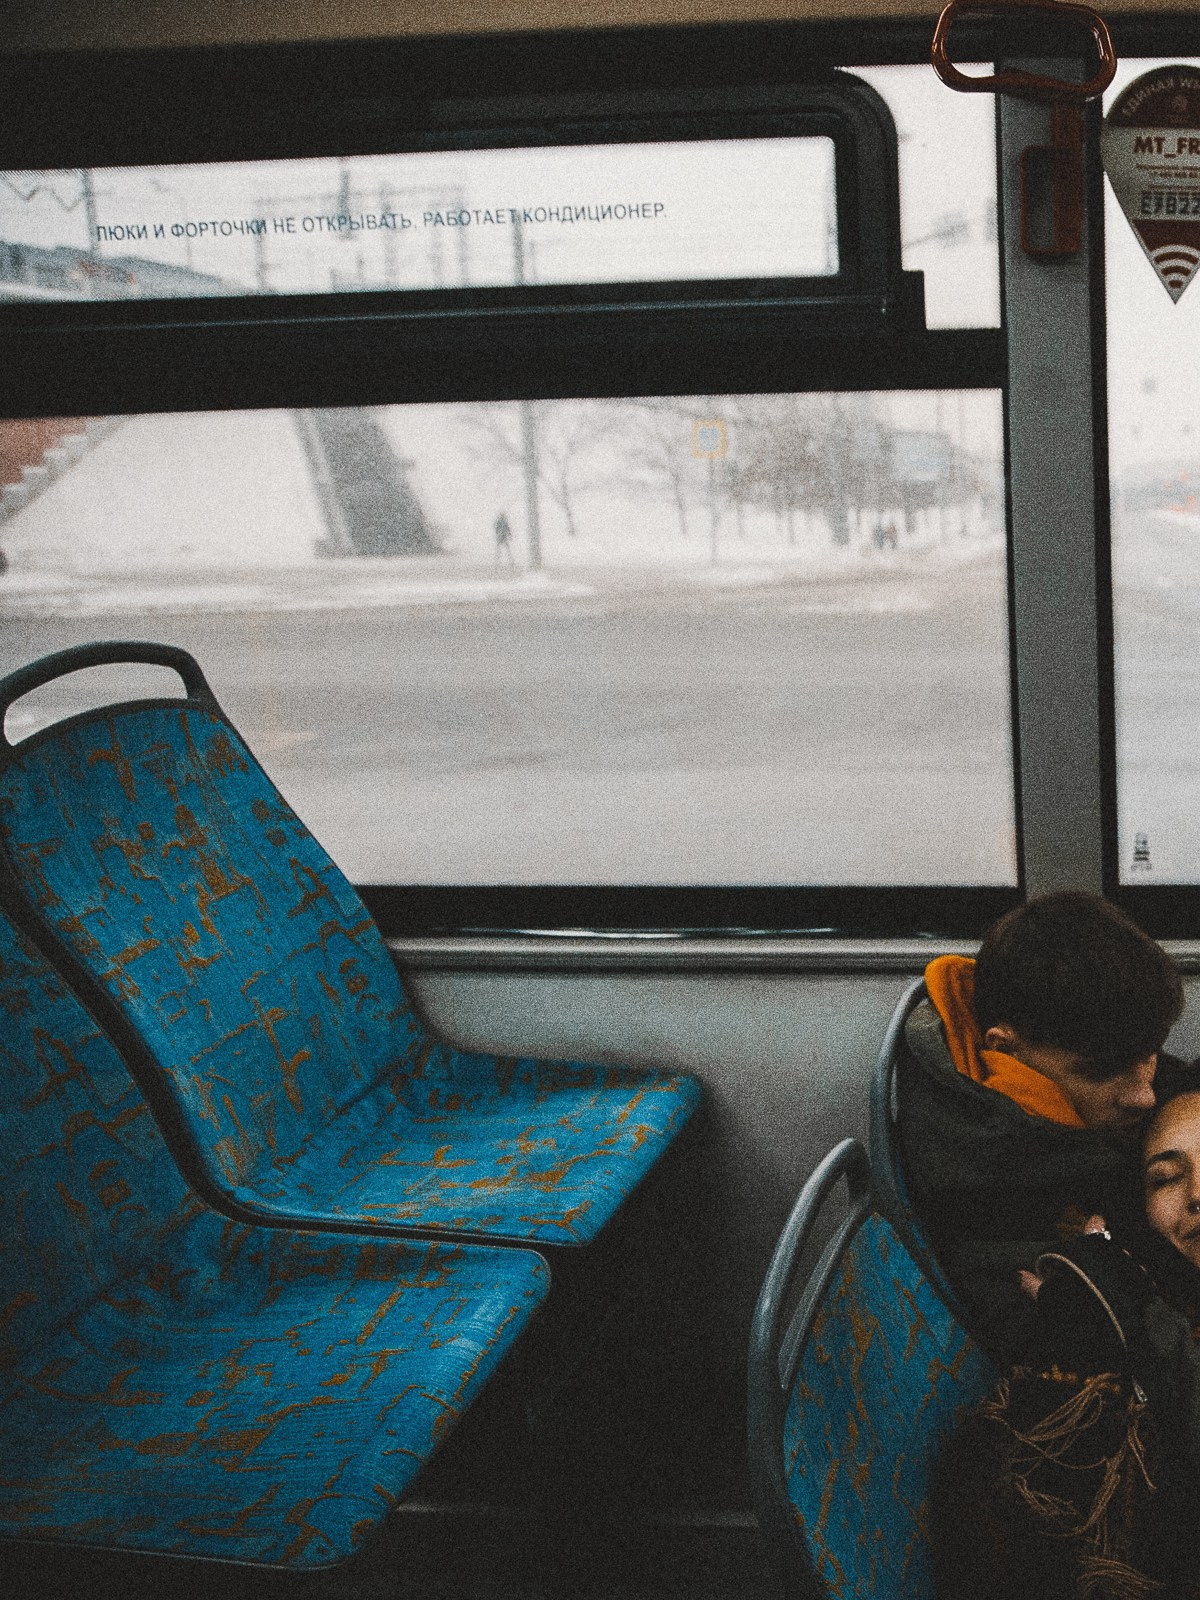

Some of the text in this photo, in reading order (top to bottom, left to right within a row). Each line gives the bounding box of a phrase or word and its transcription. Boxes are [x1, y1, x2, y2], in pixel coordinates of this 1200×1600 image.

[154, 223, 165, 239] И
[170, 218, 268, 238] ФОРТОЧКИ
[273, 217, 296, 234] НЕ
[423, 208, 516, 228] РАБОТАЕТ
[523, 202, 667, 224] КОНДИЦИОНЕР.
